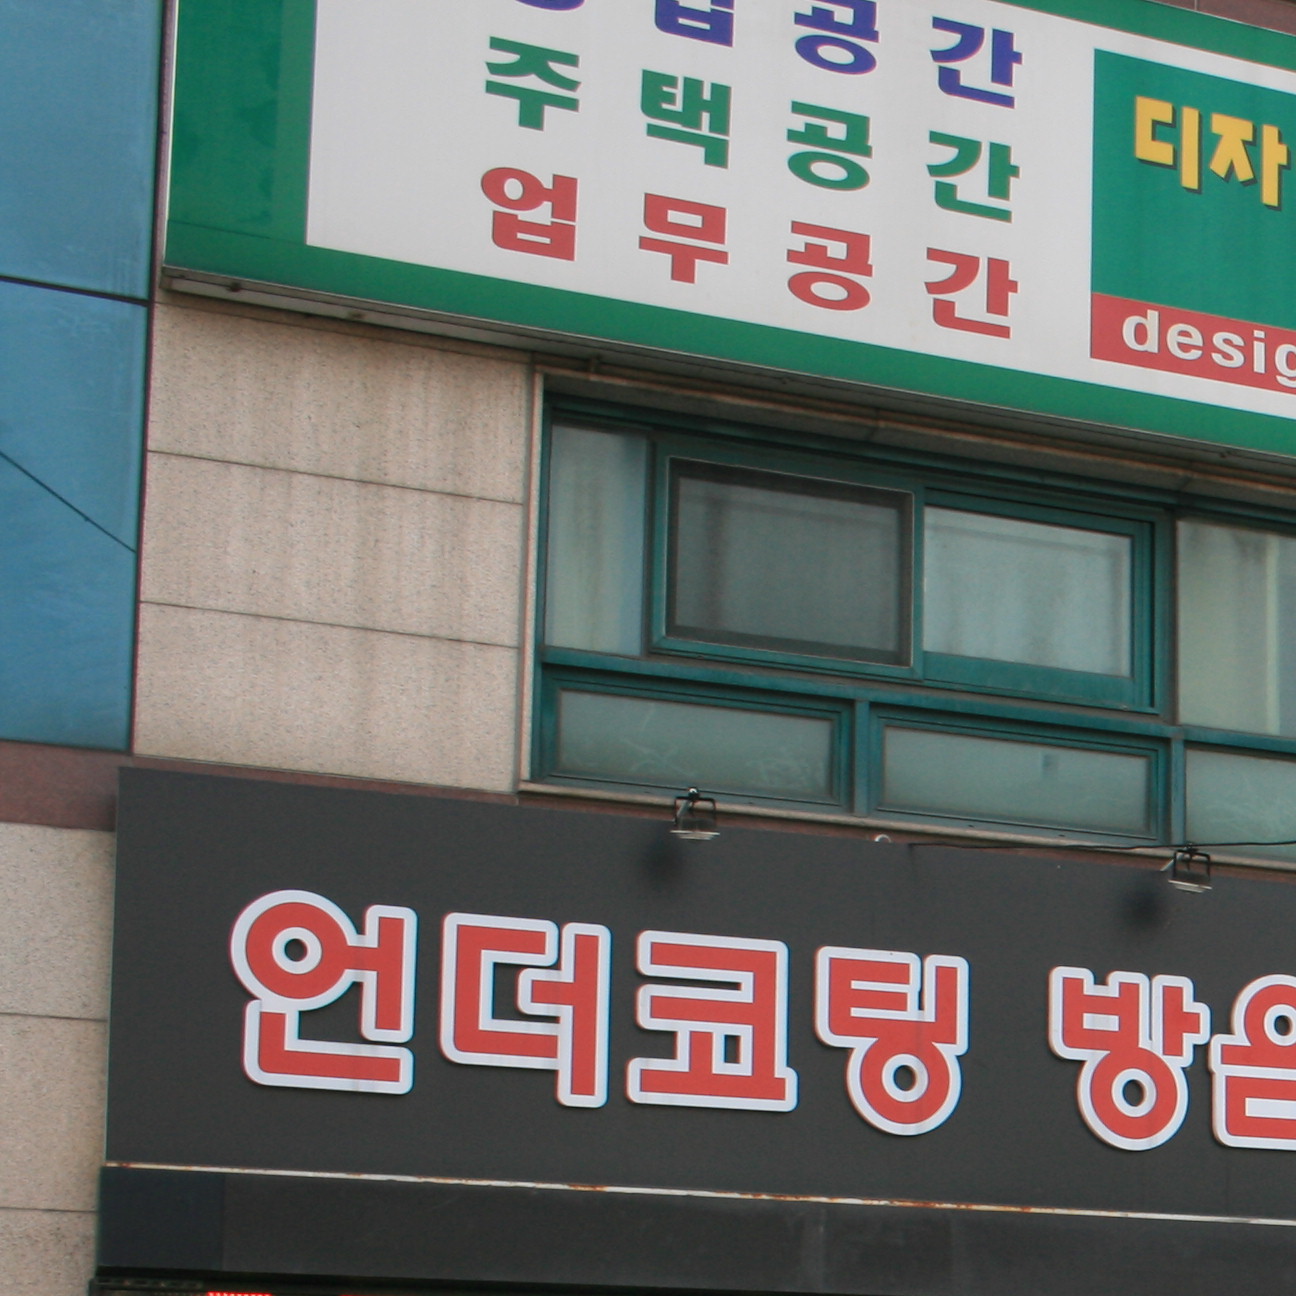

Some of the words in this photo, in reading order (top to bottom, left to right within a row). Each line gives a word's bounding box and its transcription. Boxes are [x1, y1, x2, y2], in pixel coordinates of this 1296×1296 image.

[484, 35, 1020, 223] 주택공간
[480, 165, 1019, 340] 업무공간
[230, 889, 970, 1137] 언더코팅
